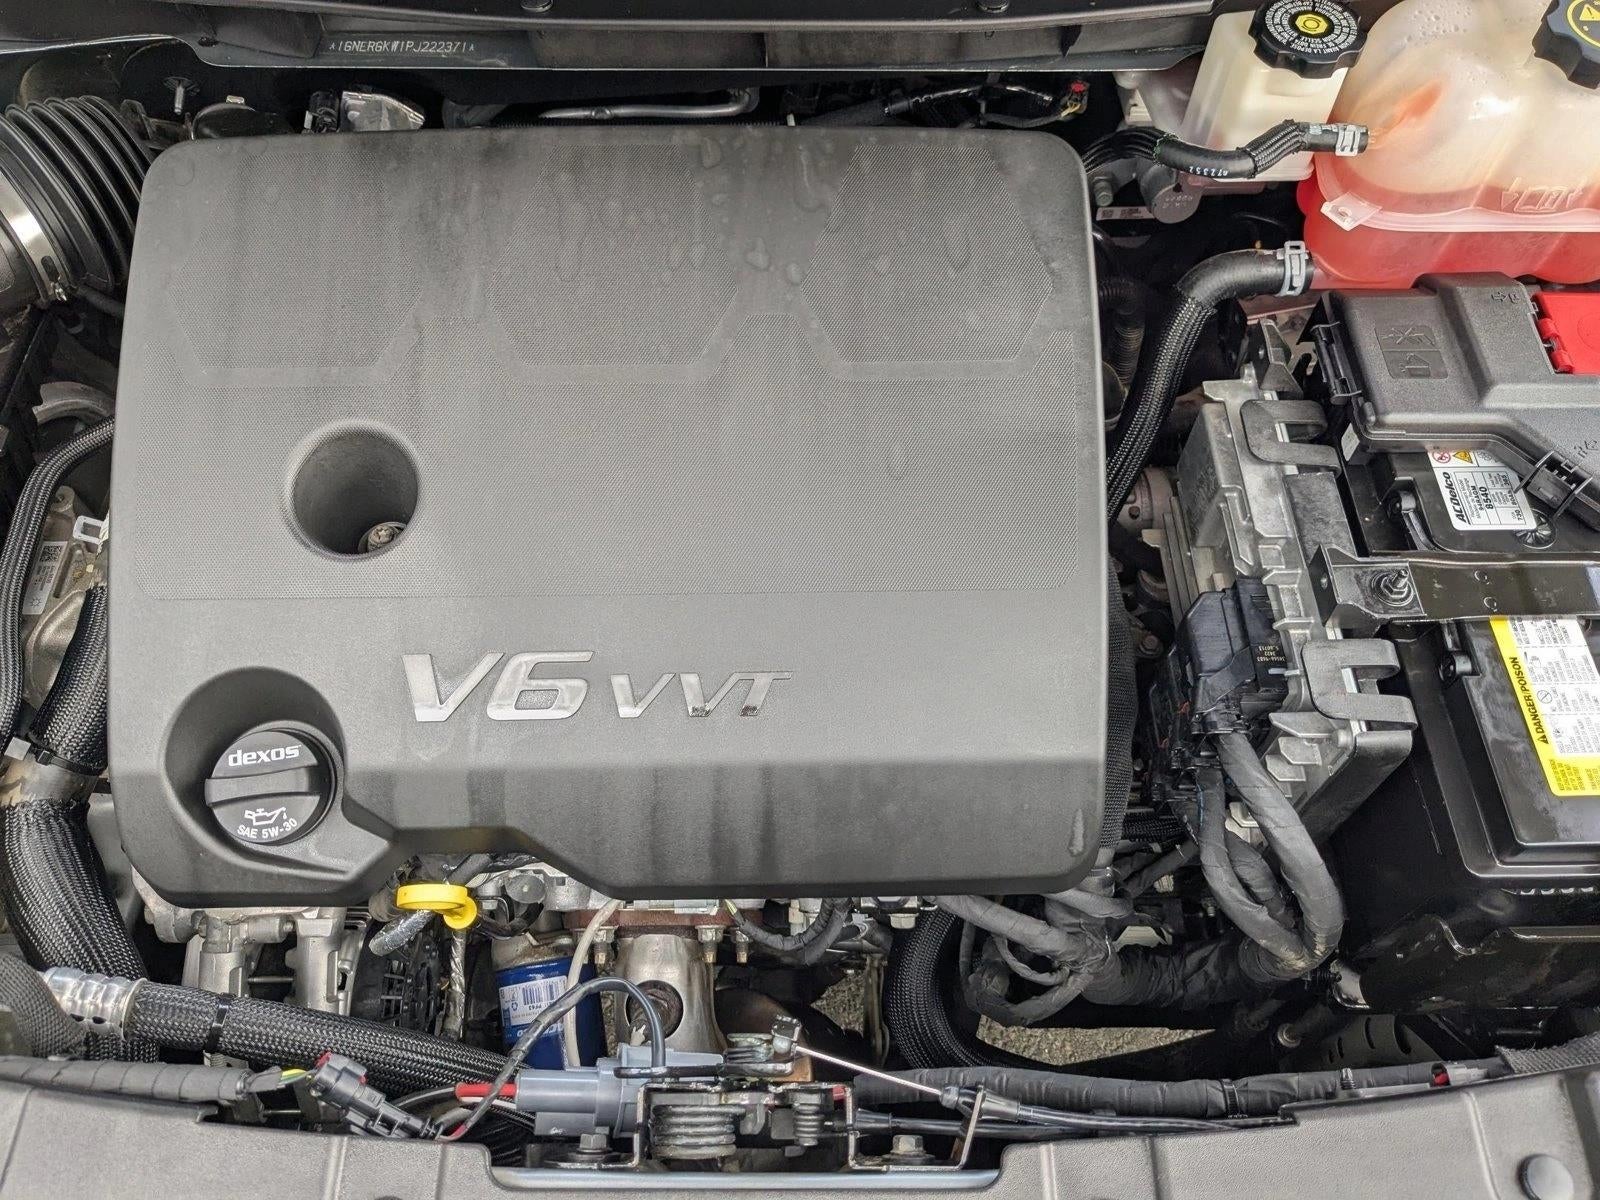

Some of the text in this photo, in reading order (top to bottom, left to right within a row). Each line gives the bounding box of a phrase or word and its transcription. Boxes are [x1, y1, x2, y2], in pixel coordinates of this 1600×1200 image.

[1442, 471, 1467, 524] ACDelco
[1479, 486, 1494, 510] 8540
[401, 651, 793, 722] V6 VVT
[228, 745, 300, 767] dexos
[237, 817, 298, 839] SAE 5W-30
